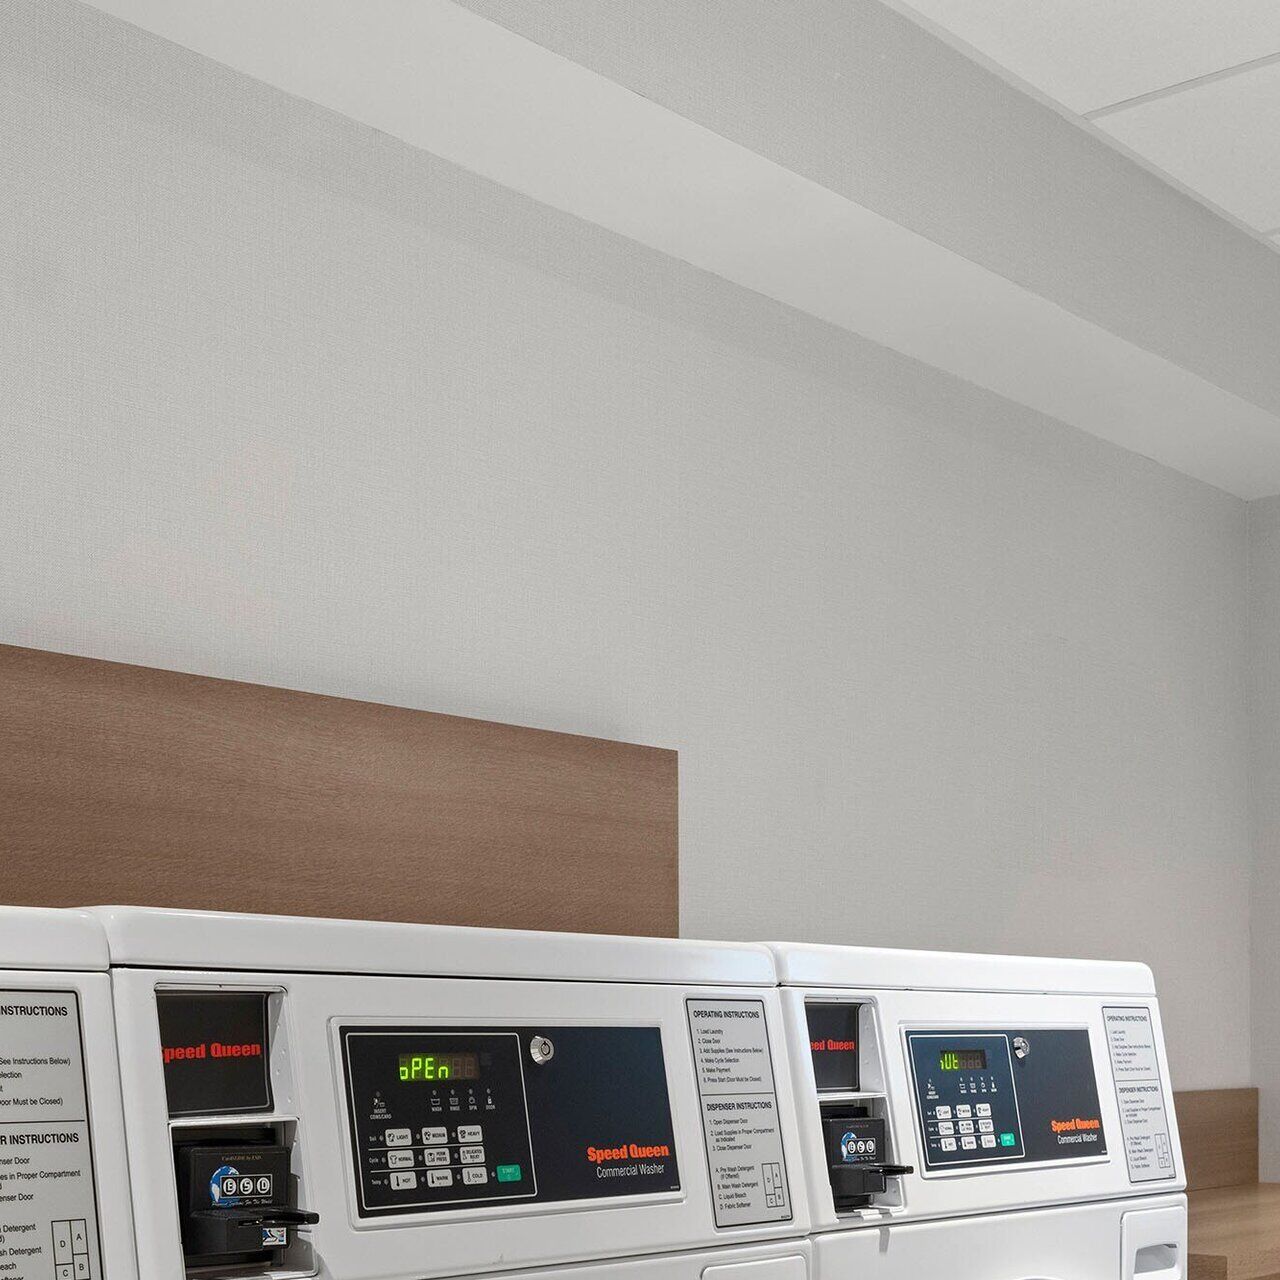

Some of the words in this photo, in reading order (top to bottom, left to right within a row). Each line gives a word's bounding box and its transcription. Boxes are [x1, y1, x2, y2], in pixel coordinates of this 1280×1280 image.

[811, 1040, 824, 1050] eed
[828, 1040, 854, 1050] Queen
[162, 1044, 206, 1063] peed
[210, 1043, 261, 1057] Queen
[39, 1098, 63, 1106] Closed)
[707, 1103, 735, 1111] DISPENSER
[737, 1102, 772, 1110] INSTRUCTIONS
[1051, 1119, 1075, 1133] Speed
[9, 1133, 79, 1145] INSTRUCTIONS
[1058, 1134, 1082, 1144] Commercial
[587, 1145, 628, 1163] Speed
[630, 1144, 669, 1158] Queen
[17, 1172, 38, 1181] Proper
[40, 1170, 81, 1180] Compartment
[597, 1165, 637, 1178] Commercial
[640, 1164, 664, 1175] Washer
[18, 1193, 33, 1201] Door
[3, 1224, 36, 1233] Detergent
[9, 1247, 42, 1257] Detergent
